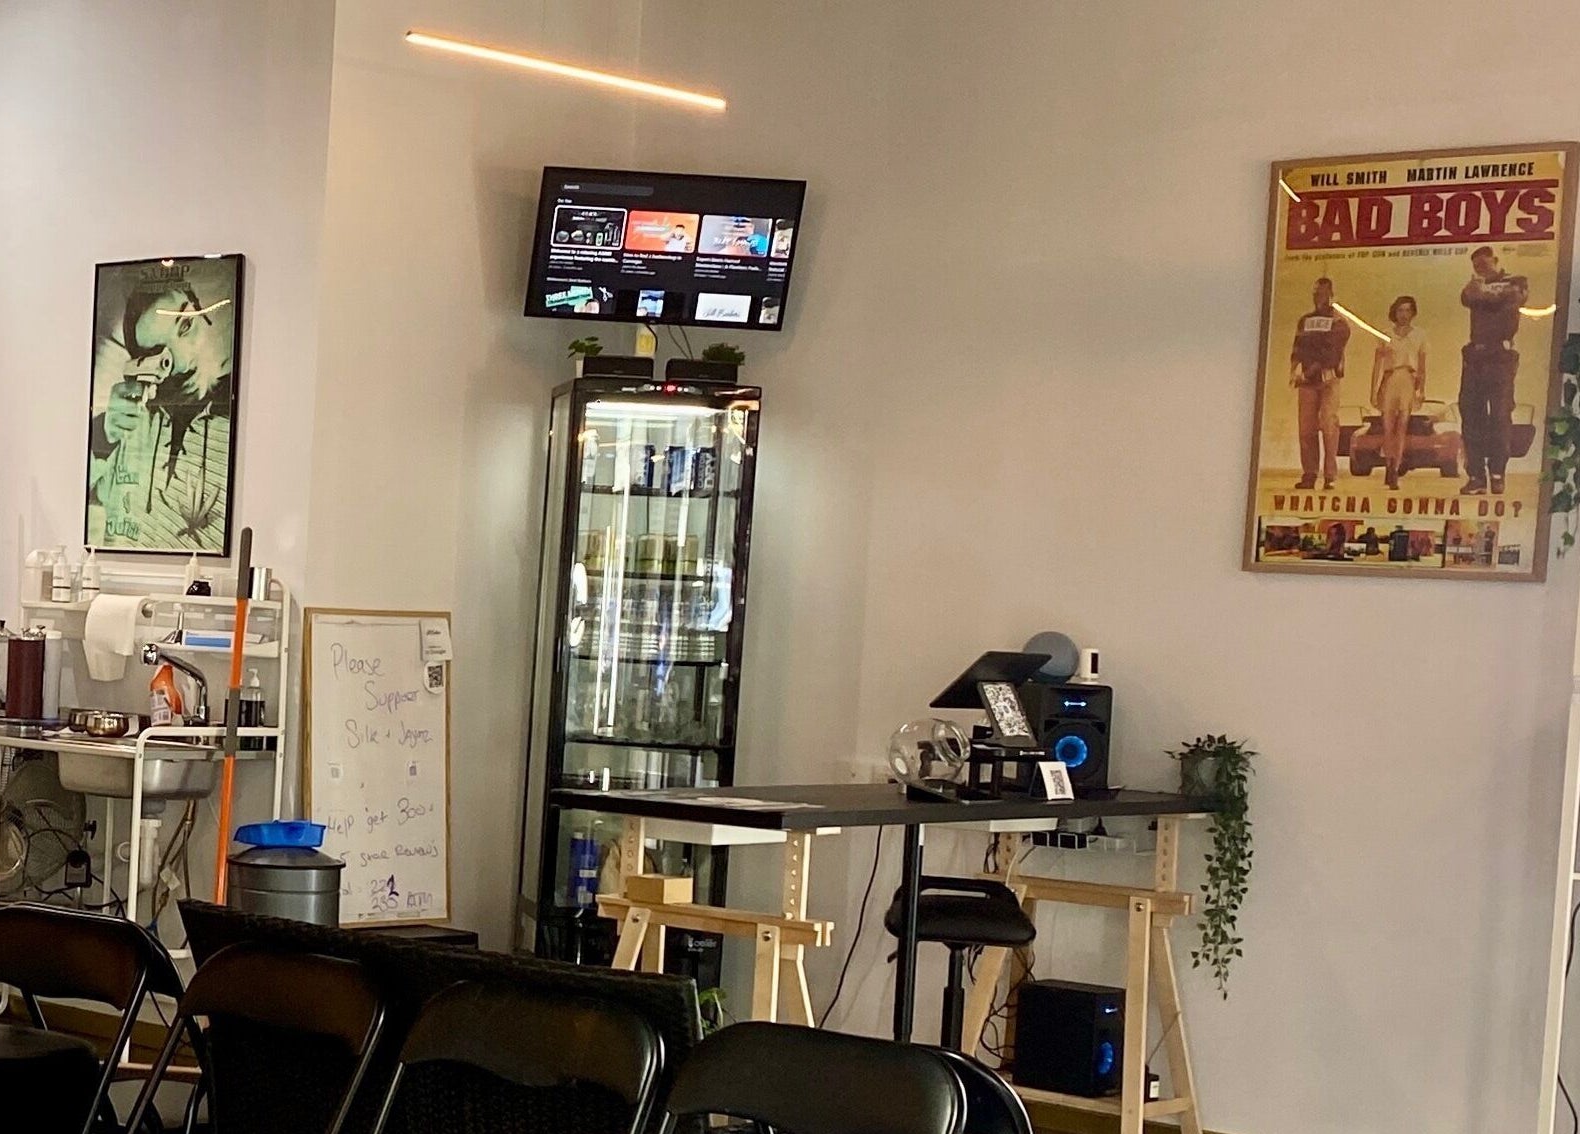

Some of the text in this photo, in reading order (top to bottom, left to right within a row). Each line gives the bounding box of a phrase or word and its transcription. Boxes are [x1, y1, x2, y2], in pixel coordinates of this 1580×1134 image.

[1310, 162, 1535, 187] WILL SMITH MARTIN LAWRENCE
[1287, 188, 1556, 246] BAD BOYS
[1273, 495, 1522, 518] WHATCHA GONNA DO?
[330, 642, 385, 680] Please
[366, 810, 389, 834] get
